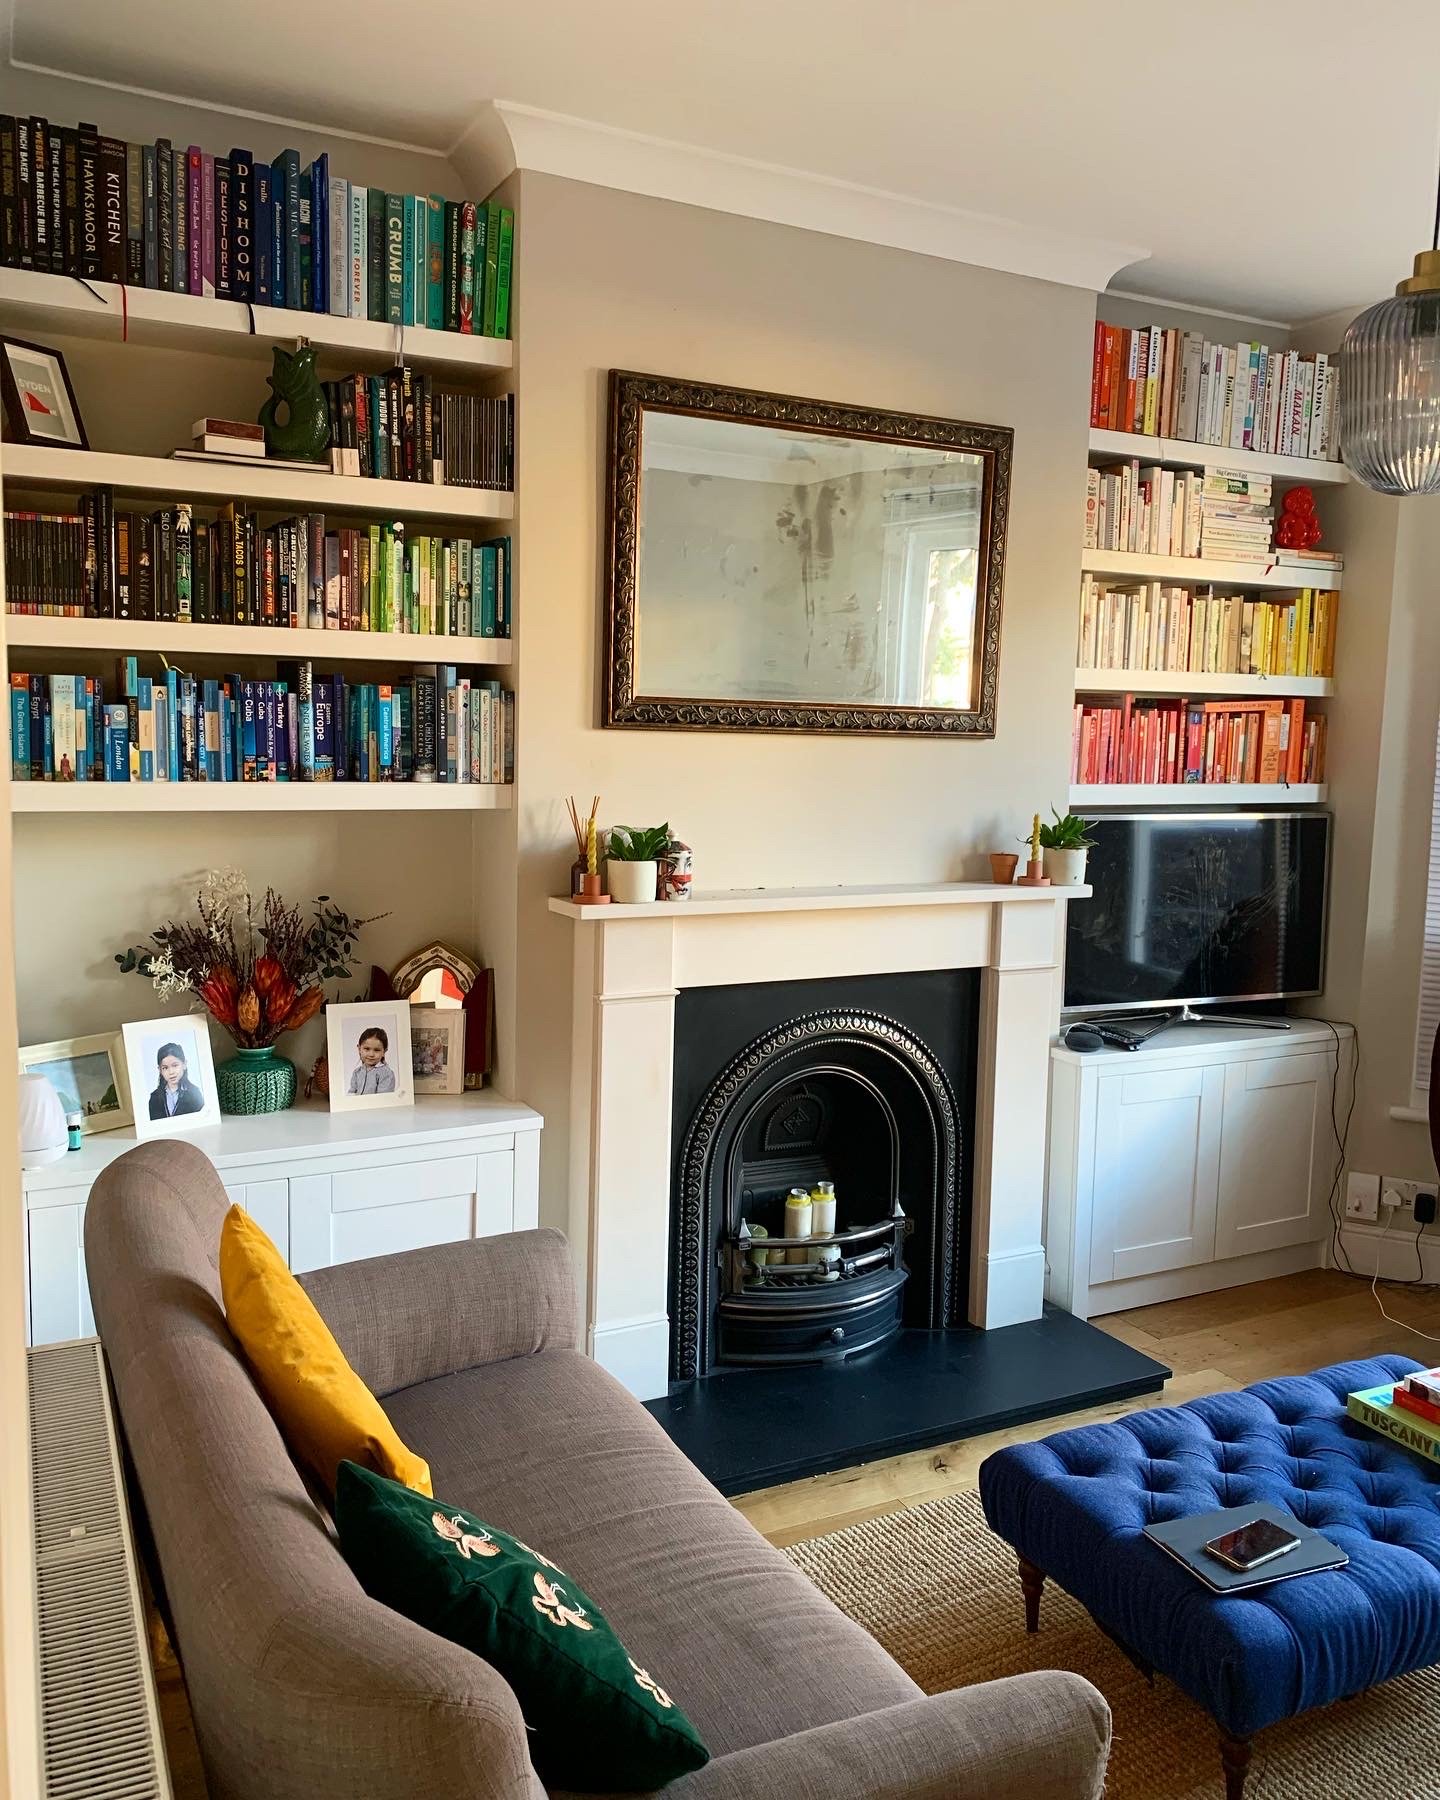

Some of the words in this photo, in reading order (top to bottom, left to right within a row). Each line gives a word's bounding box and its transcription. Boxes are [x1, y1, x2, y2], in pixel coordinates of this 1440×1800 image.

[19, 125, 28, 150] FINCH
[20, 151, 29, 183] BAKERY
[52, 150, 60, 165] THE
[52, 167, 60, 187] MEAL
[177, 154, 185, 198] MARCUS
[36, 171, 46, 217] BARBECUE
[84, 159, 96, 252] HAWKSMOOR
[260, 180, 268, 203] trullo
[53, 209, 61, 229] KING
[107, 172, 120, 244] KITCHEN
[299, 199, 311, 224] BACON
[37, 218, 46, 244] BIBLE
[177, 202, 186, 251] WAREING
[221, 181, 229, 279] RESTORE
[235, 164, 251, 283] DISHOOM
[389, 216, 402, 284] CRUMB
[1151, 331, 1159, 374] Lisboeta
[1314, 360, 1326, 418] BRINDISA
[379, 400, 388, 425] WIDOW
[1291, 389, 1303, 436] MAKAN
[162, 512, 170, 531] SILO
[235, 541, 244, 566] TACOS
[473, 553, 481, 594] LAGOM
[31, 696, 40, 719] Egypt
[129, 698, 137, 715] Little
[244, 699, 254, 722] Cuba
[424, 685, 433, 714] DICKENS
[129, 717, 138, 741] Foodie
[277, 702, 285, 729] Turkey
[315, 703, 326, 740] Europe
[18, 734, 26, 759] Islands
[114, 740, 125, 770] London
[424, 722, 433, 759] CHRISTMAS
[1362, 1406, 1433, 1453] TUSCANY
